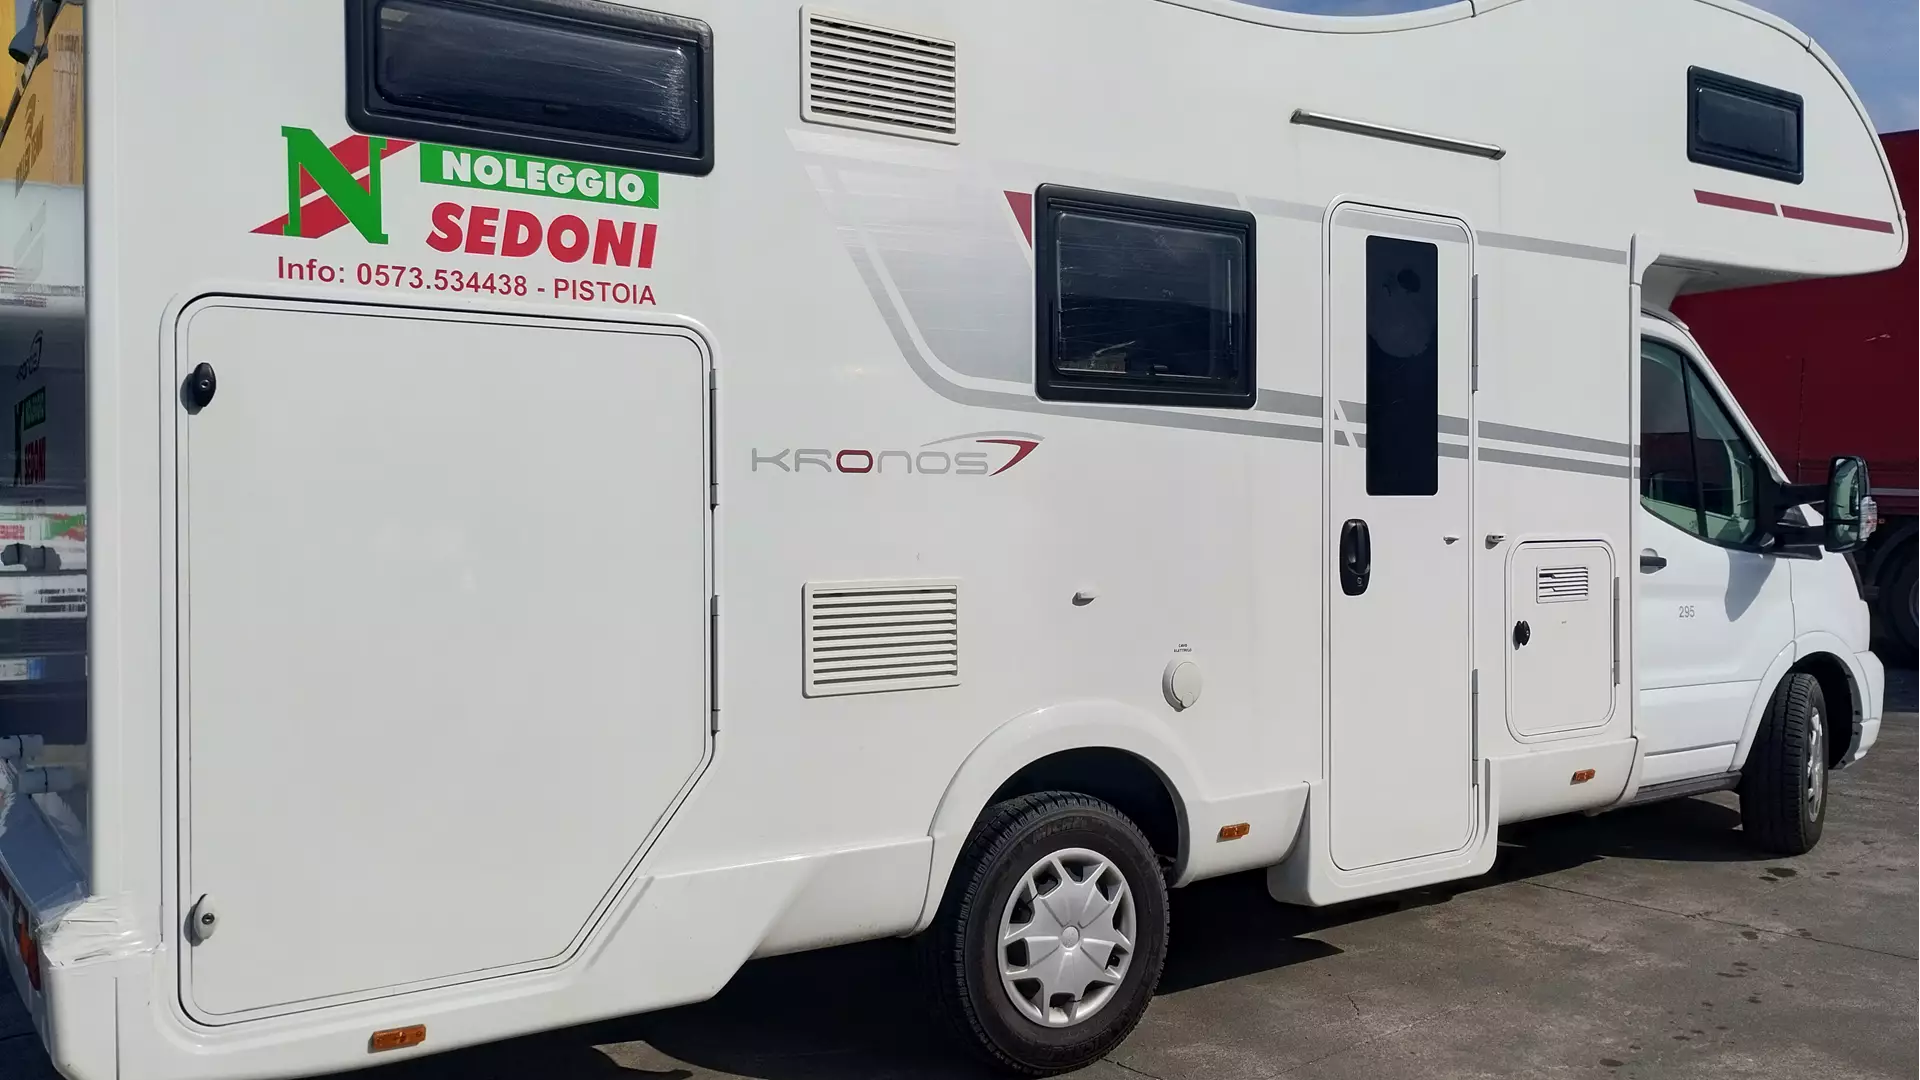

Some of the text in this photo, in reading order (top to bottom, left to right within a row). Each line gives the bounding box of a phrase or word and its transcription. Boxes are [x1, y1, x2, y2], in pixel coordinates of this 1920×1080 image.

[442, 150, 646, 202] NOLEGGIO
[425, 202, 658, 269] SEDONI
[277, 256, 345, 283] Info:
[356, 263, 528, 296] 0573.534438
[554, 278, 657, 305] PISTOIA
[1679, 605, 1695, 618] 295
